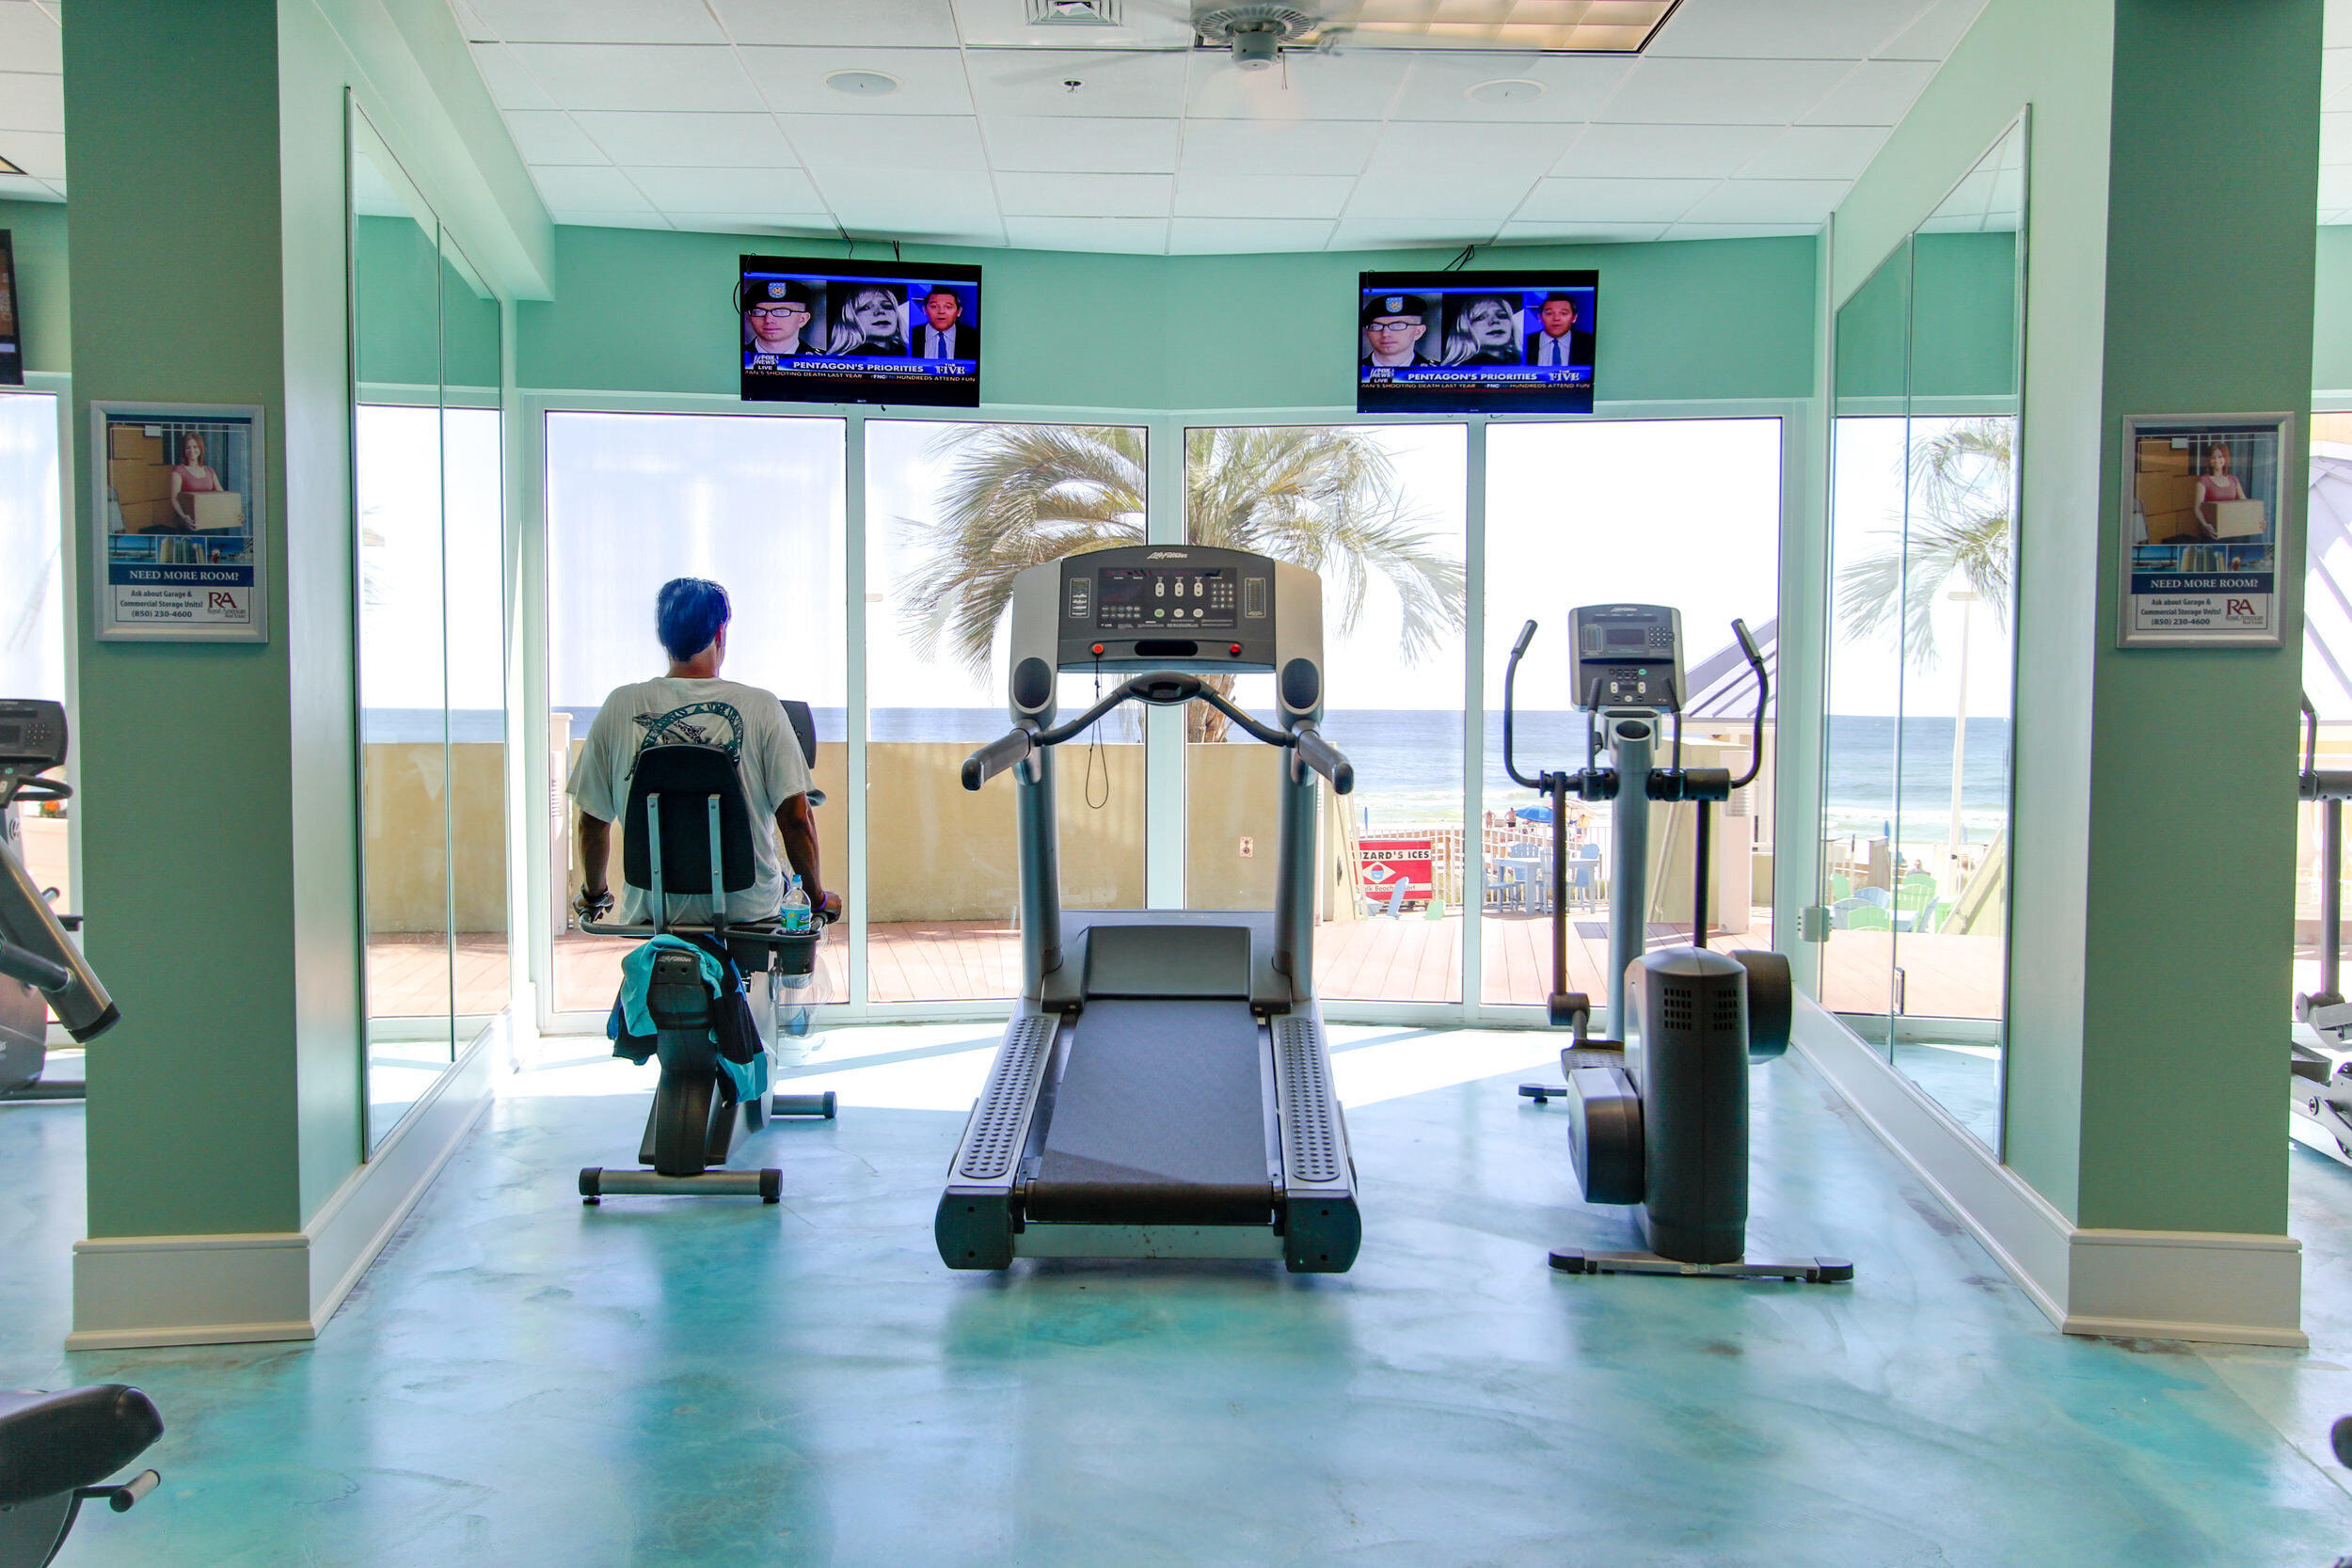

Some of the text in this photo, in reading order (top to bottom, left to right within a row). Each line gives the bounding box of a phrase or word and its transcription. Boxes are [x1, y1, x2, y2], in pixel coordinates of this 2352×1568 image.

[793, 361, 924, 372] PENTAGON'S PRIORITIES
[935, 365, 966, 374] FIVE
[1549, 372, 1581, 381] FIVE
[129, 570, 239, 581] NEED MORE ROOM?
[2151, 578, 2259, 588] NEED MORE ROOM?
[163, 591, 186, 599] Garage
[158, 600, 183, 610] Storage
[208, 592, 238, 609] RA
[2226, 599, 2256, 615] RA
[132, 610, 152, 618] (850)
[1407, 850, 1429, 859] ICES
